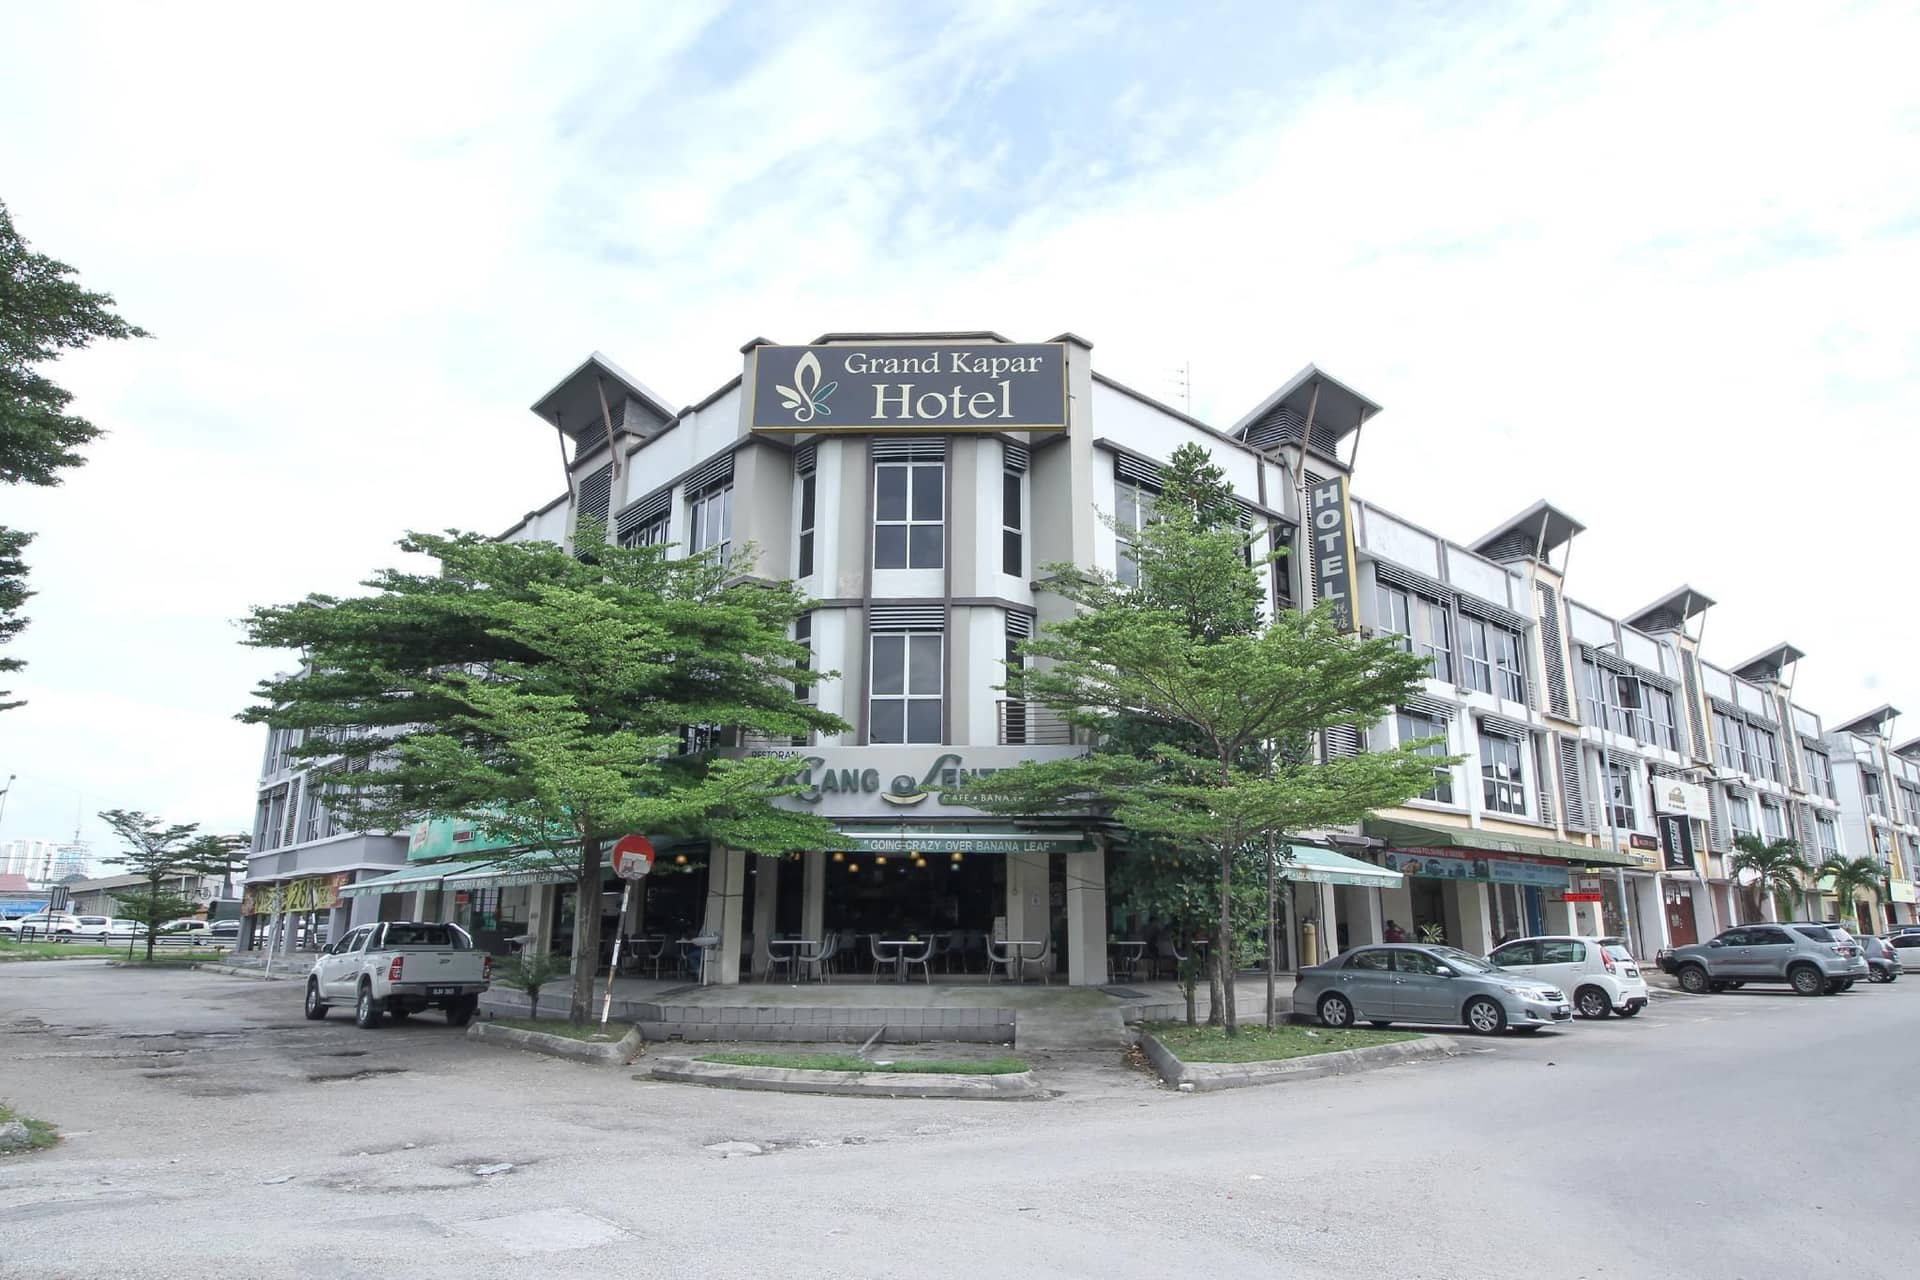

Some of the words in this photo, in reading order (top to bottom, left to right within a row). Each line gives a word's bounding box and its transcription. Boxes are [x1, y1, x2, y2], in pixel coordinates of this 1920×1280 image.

[844, 352, 939, 374] Grand
[950, 352, 1043, 379] Kapar
[870, 380, 1015, 420] Hotel
[1315, 484, 1345, 600] HOTEL
[905, 839, 940, 850] CRAZY
[946, 840, 973, 850] OVER
[977, 840, 1019, 851] BANANA
